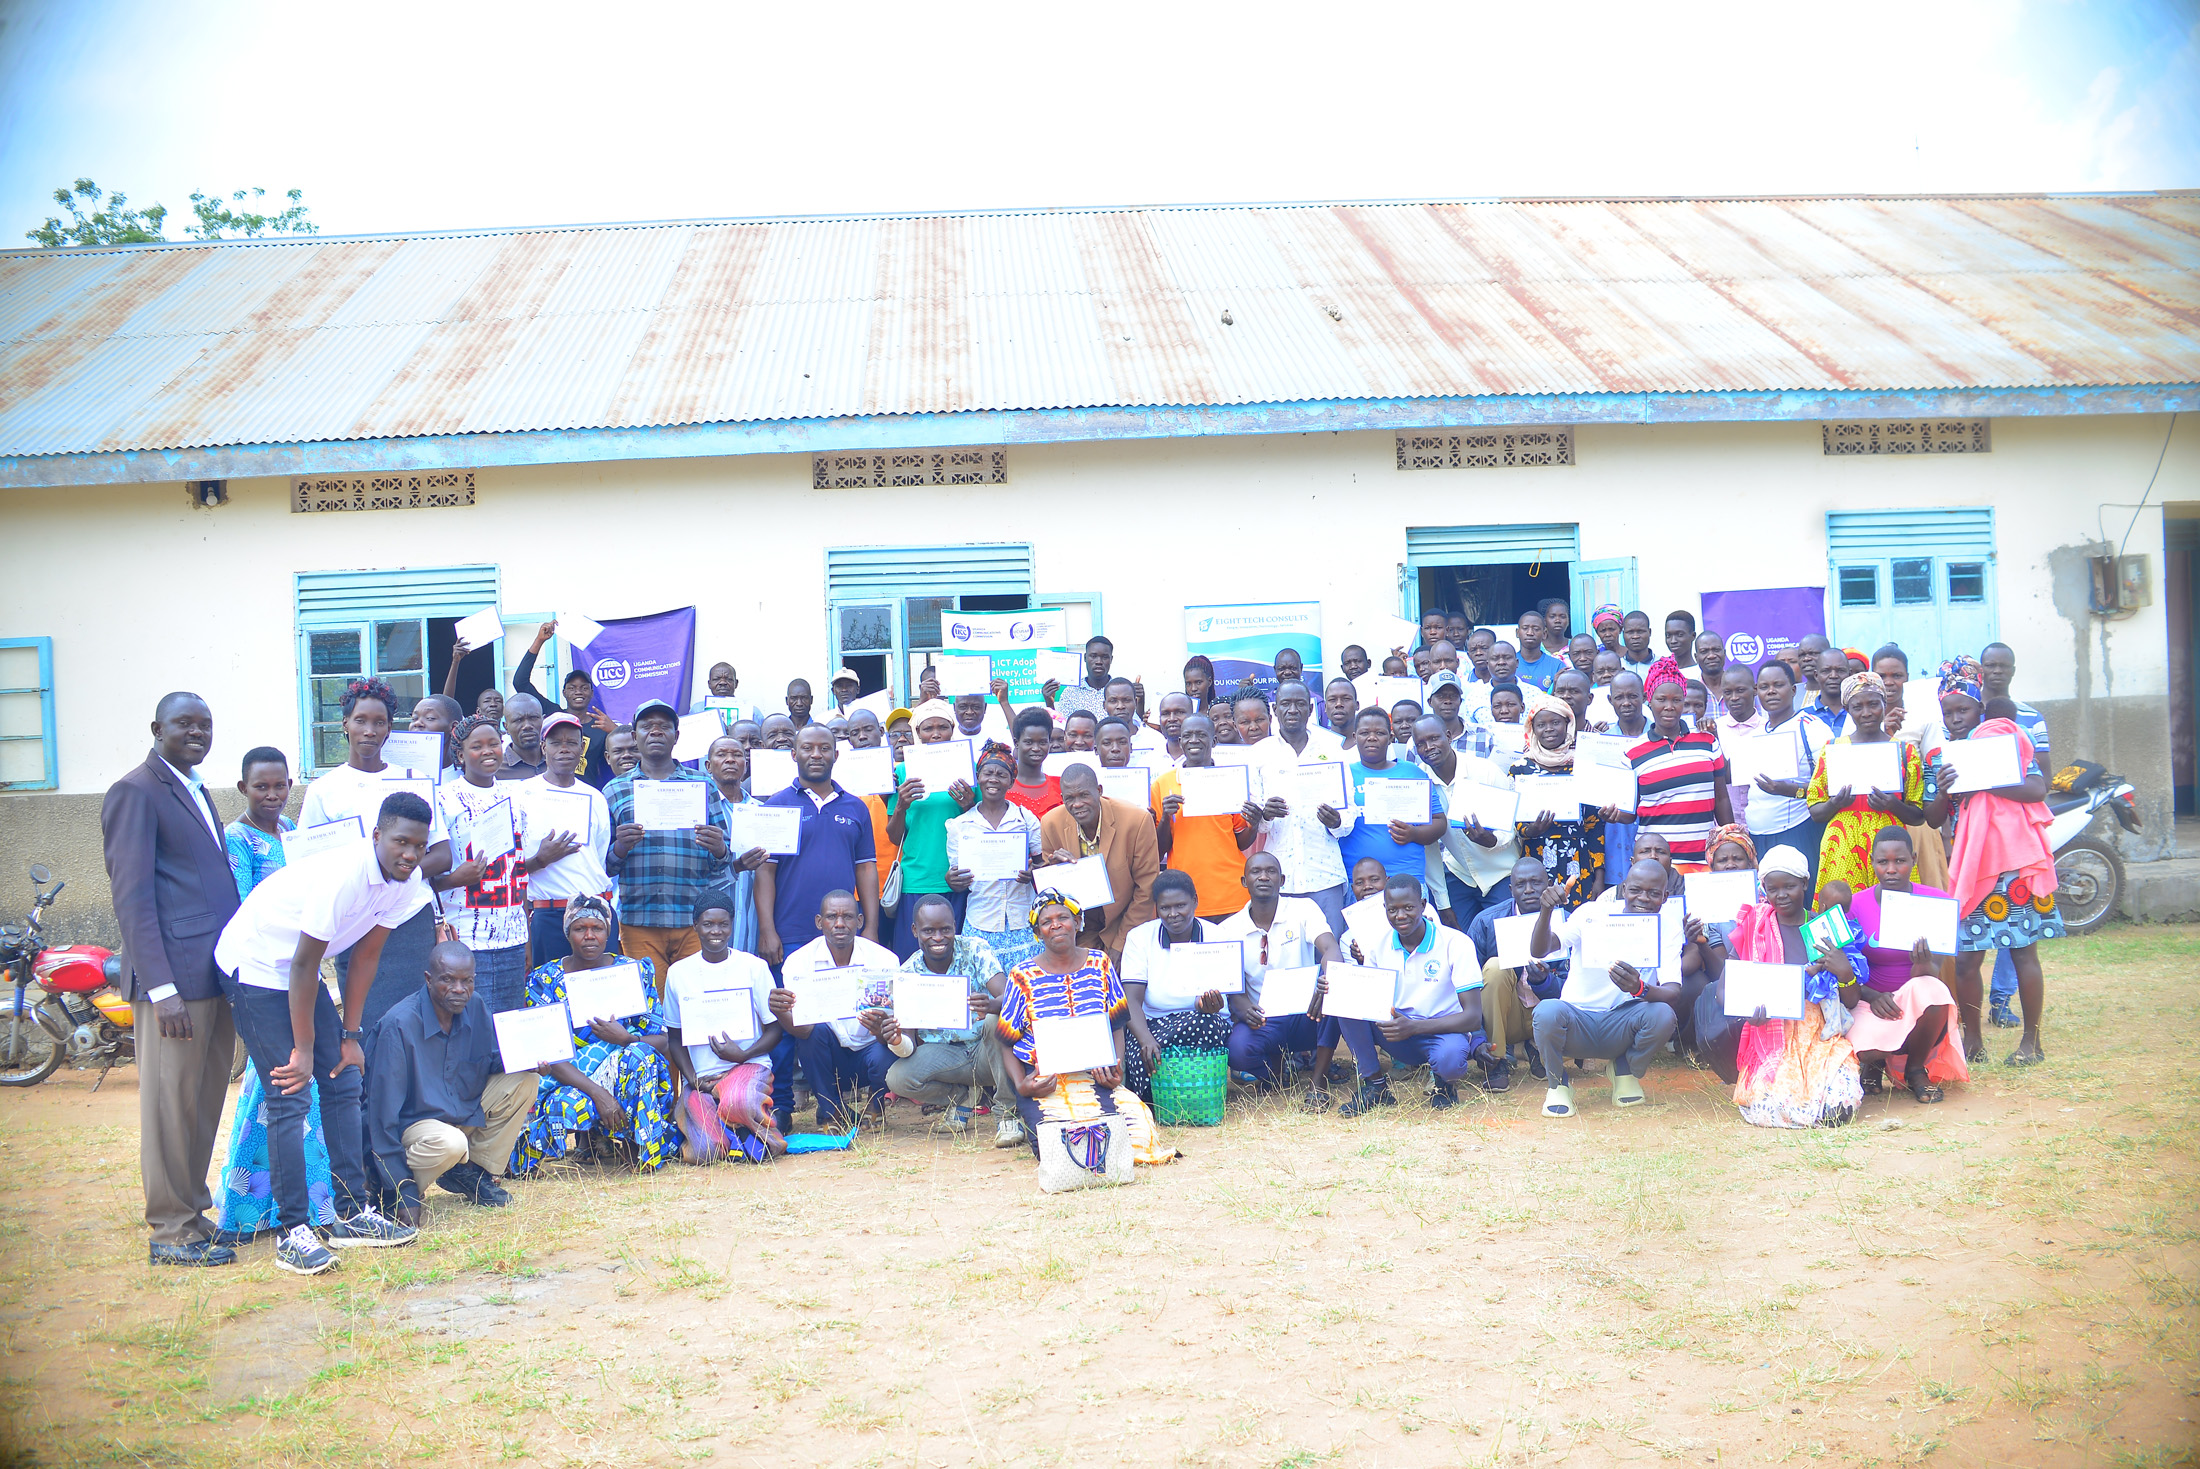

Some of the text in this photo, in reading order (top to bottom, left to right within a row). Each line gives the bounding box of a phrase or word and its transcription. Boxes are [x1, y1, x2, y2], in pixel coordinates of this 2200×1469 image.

[1215, 614, 1309, 625] EIGHT TECH CONSULTS
[1766, 642, 1801, 650] COMMUNICA
[634, 660, 681, 674] COMMUNICATIONS
[997, 659, 1012, 667] ICT
[634, 670, 669, 680] COMMISSION
[991, 668, 1021, 677] elivery,
[1009, 678, 1032, 686] Skills
[1226, 678, 1241, 686] KNO
[1252, 677, 1268, 685] OUR
